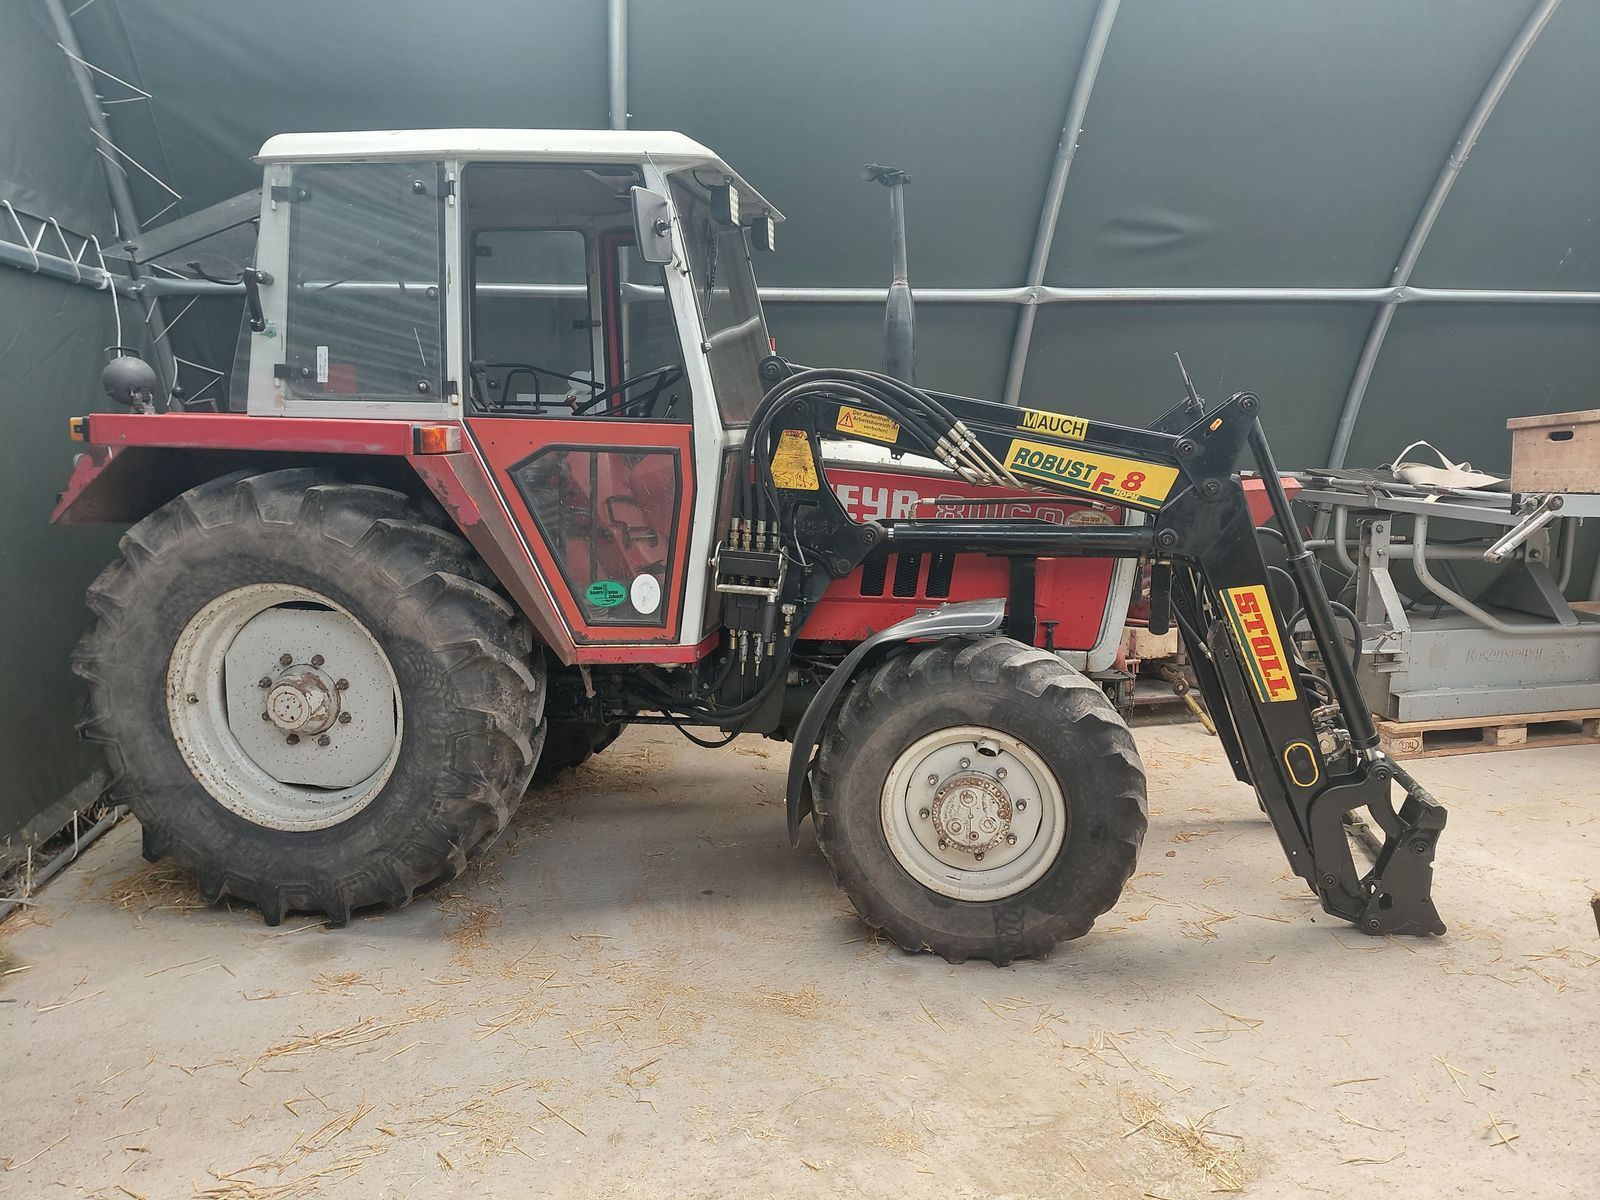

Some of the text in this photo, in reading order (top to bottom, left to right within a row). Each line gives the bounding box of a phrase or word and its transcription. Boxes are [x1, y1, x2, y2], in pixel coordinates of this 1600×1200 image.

[852, 416, 891, 429] Arbeitsbereich
[863, 424, 889, 434] verboten!
[1022, 411, 1086, 437] MAUCH
[1013, 447, 1098, 481] ROBUST
[829, 483, 919, 521] EYR
[1113, 489, 1140, 501] HDPM
[1233, 592, 1291, 697] STOLL
